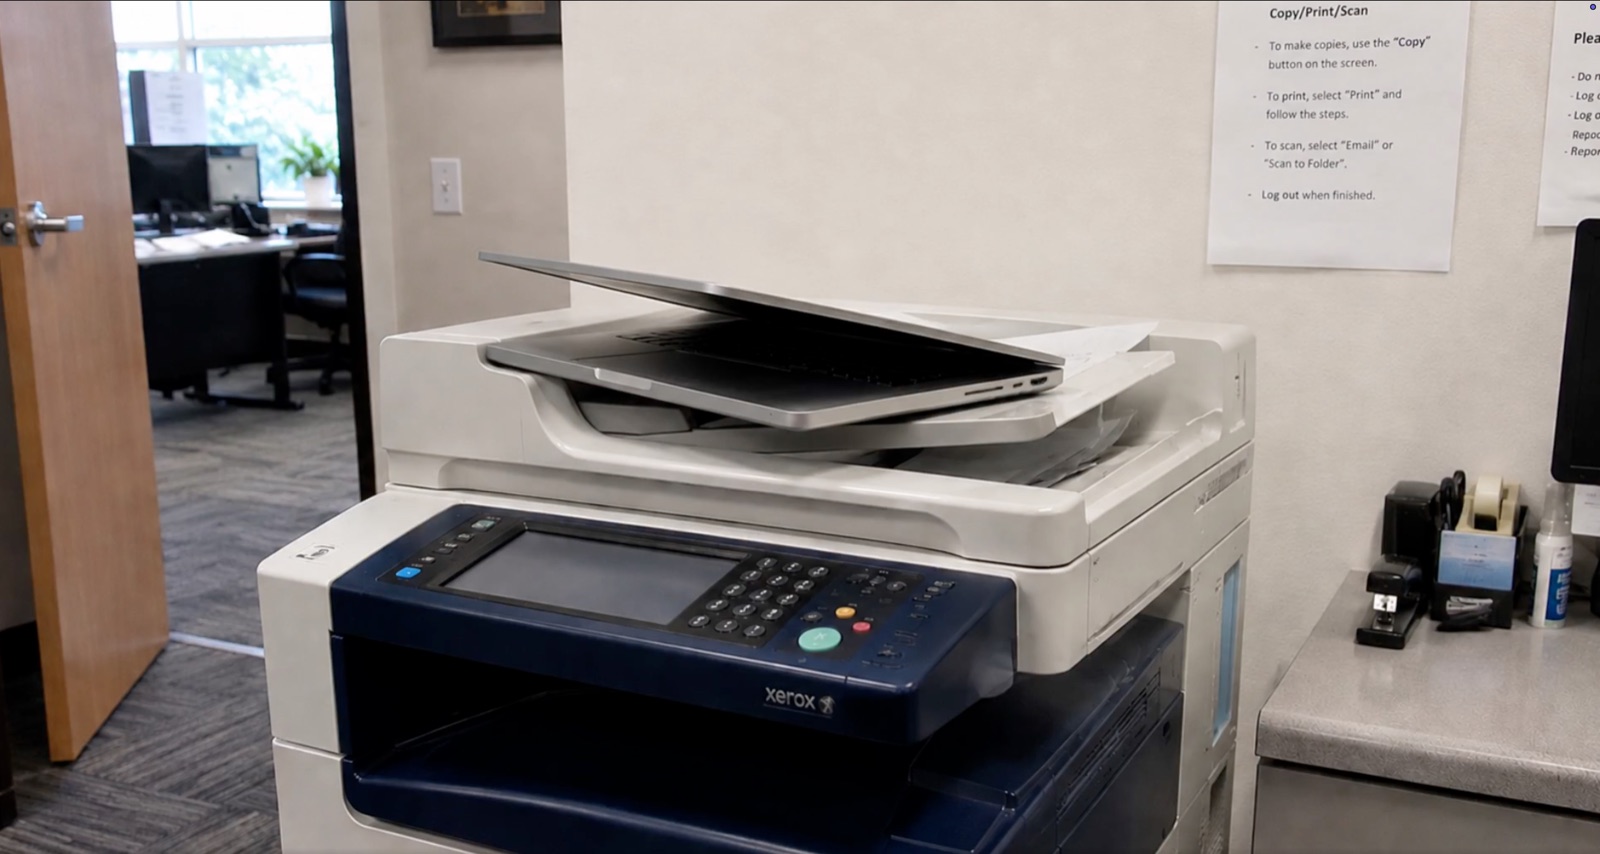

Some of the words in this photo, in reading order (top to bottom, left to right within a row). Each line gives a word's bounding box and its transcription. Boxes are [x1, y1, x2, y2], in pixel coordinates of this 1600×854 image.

[1269, 4, 1369, 21] Copy/Print/Scan
[1269, 41, 1282, 52] To
[1283, 39, 1312, 51] make
[1313, 39, 1350, 52] copies,
[1352, 40, 1371, 49] use
[1372, 37, 1391, 48] the
[1573, 31, 1600, 45] Plea
[1268, 59, 1303, 70] button
[1304, 60, 1319, 69] on
[1320, 58, 1338, 69] the
[1340, 59, 1378, 68] screen.
[1577, 71, 1592, 82] Do
[1266, 91, 1280, 102] To
[1281, 90, 1310, 104] print,
[1311, 90, 1342, 101] select
[1382, 88, 1403, 100] and
[1575, 91, 1595, 103] Log
[1265, 109, 1298, 120] follow
[1299, 108, 1317, 120] the
[1319, 109, 1349, 121] steps.
[1573, 110, 1593, 123] Log
[1264, 140, 1278, 151] To
[1279, 142, 1306, 152] scan,
[1308, 140, 1338, 151] select
[1381, 141, 1394, 150] or
[1294, 159, 1306, 169] to
[1261, 190, 1280, 202] Log
[1282, 191, 1300, 200] out
[1301, 189, 1331, 201] when
[1332, 189, 1376, 201] finished.
[765, 686, 816, 710] xerox
